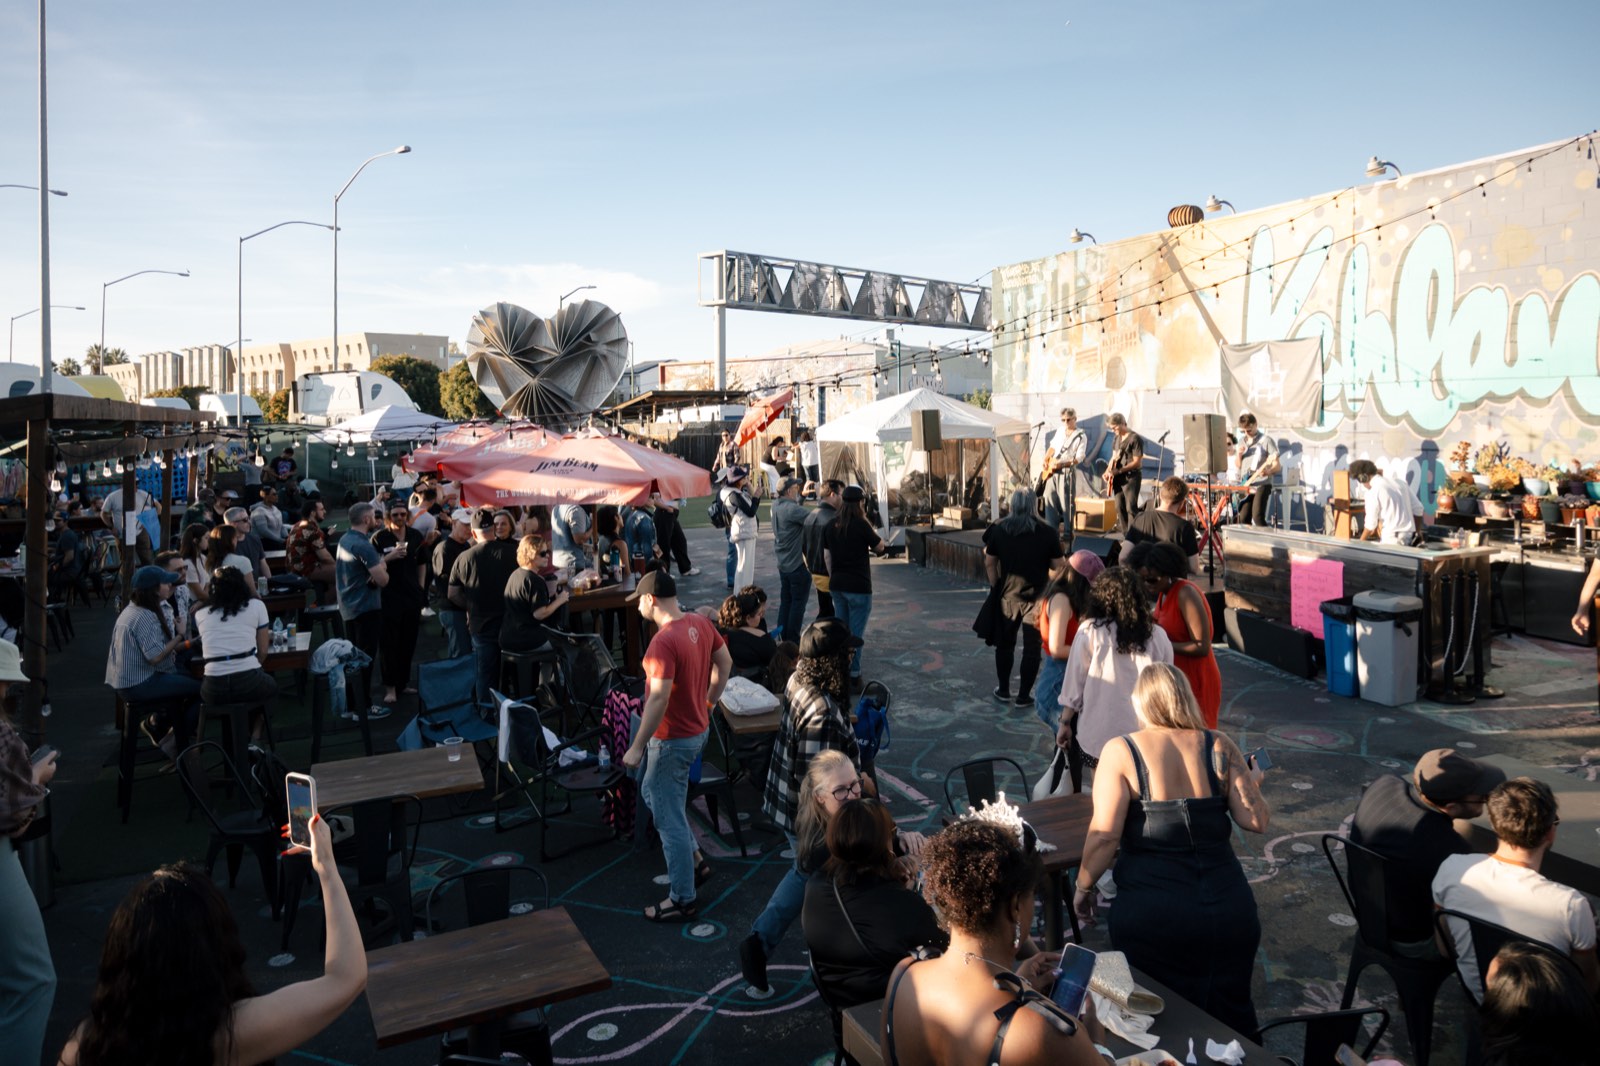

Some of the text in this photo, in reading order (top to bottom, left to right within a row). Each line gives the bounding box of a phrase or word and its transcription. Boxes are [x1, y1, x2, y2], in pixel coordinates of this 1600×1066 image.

[529, 457, 599, 473] JIM BEAM
[495, 490, 509, 498] THE
